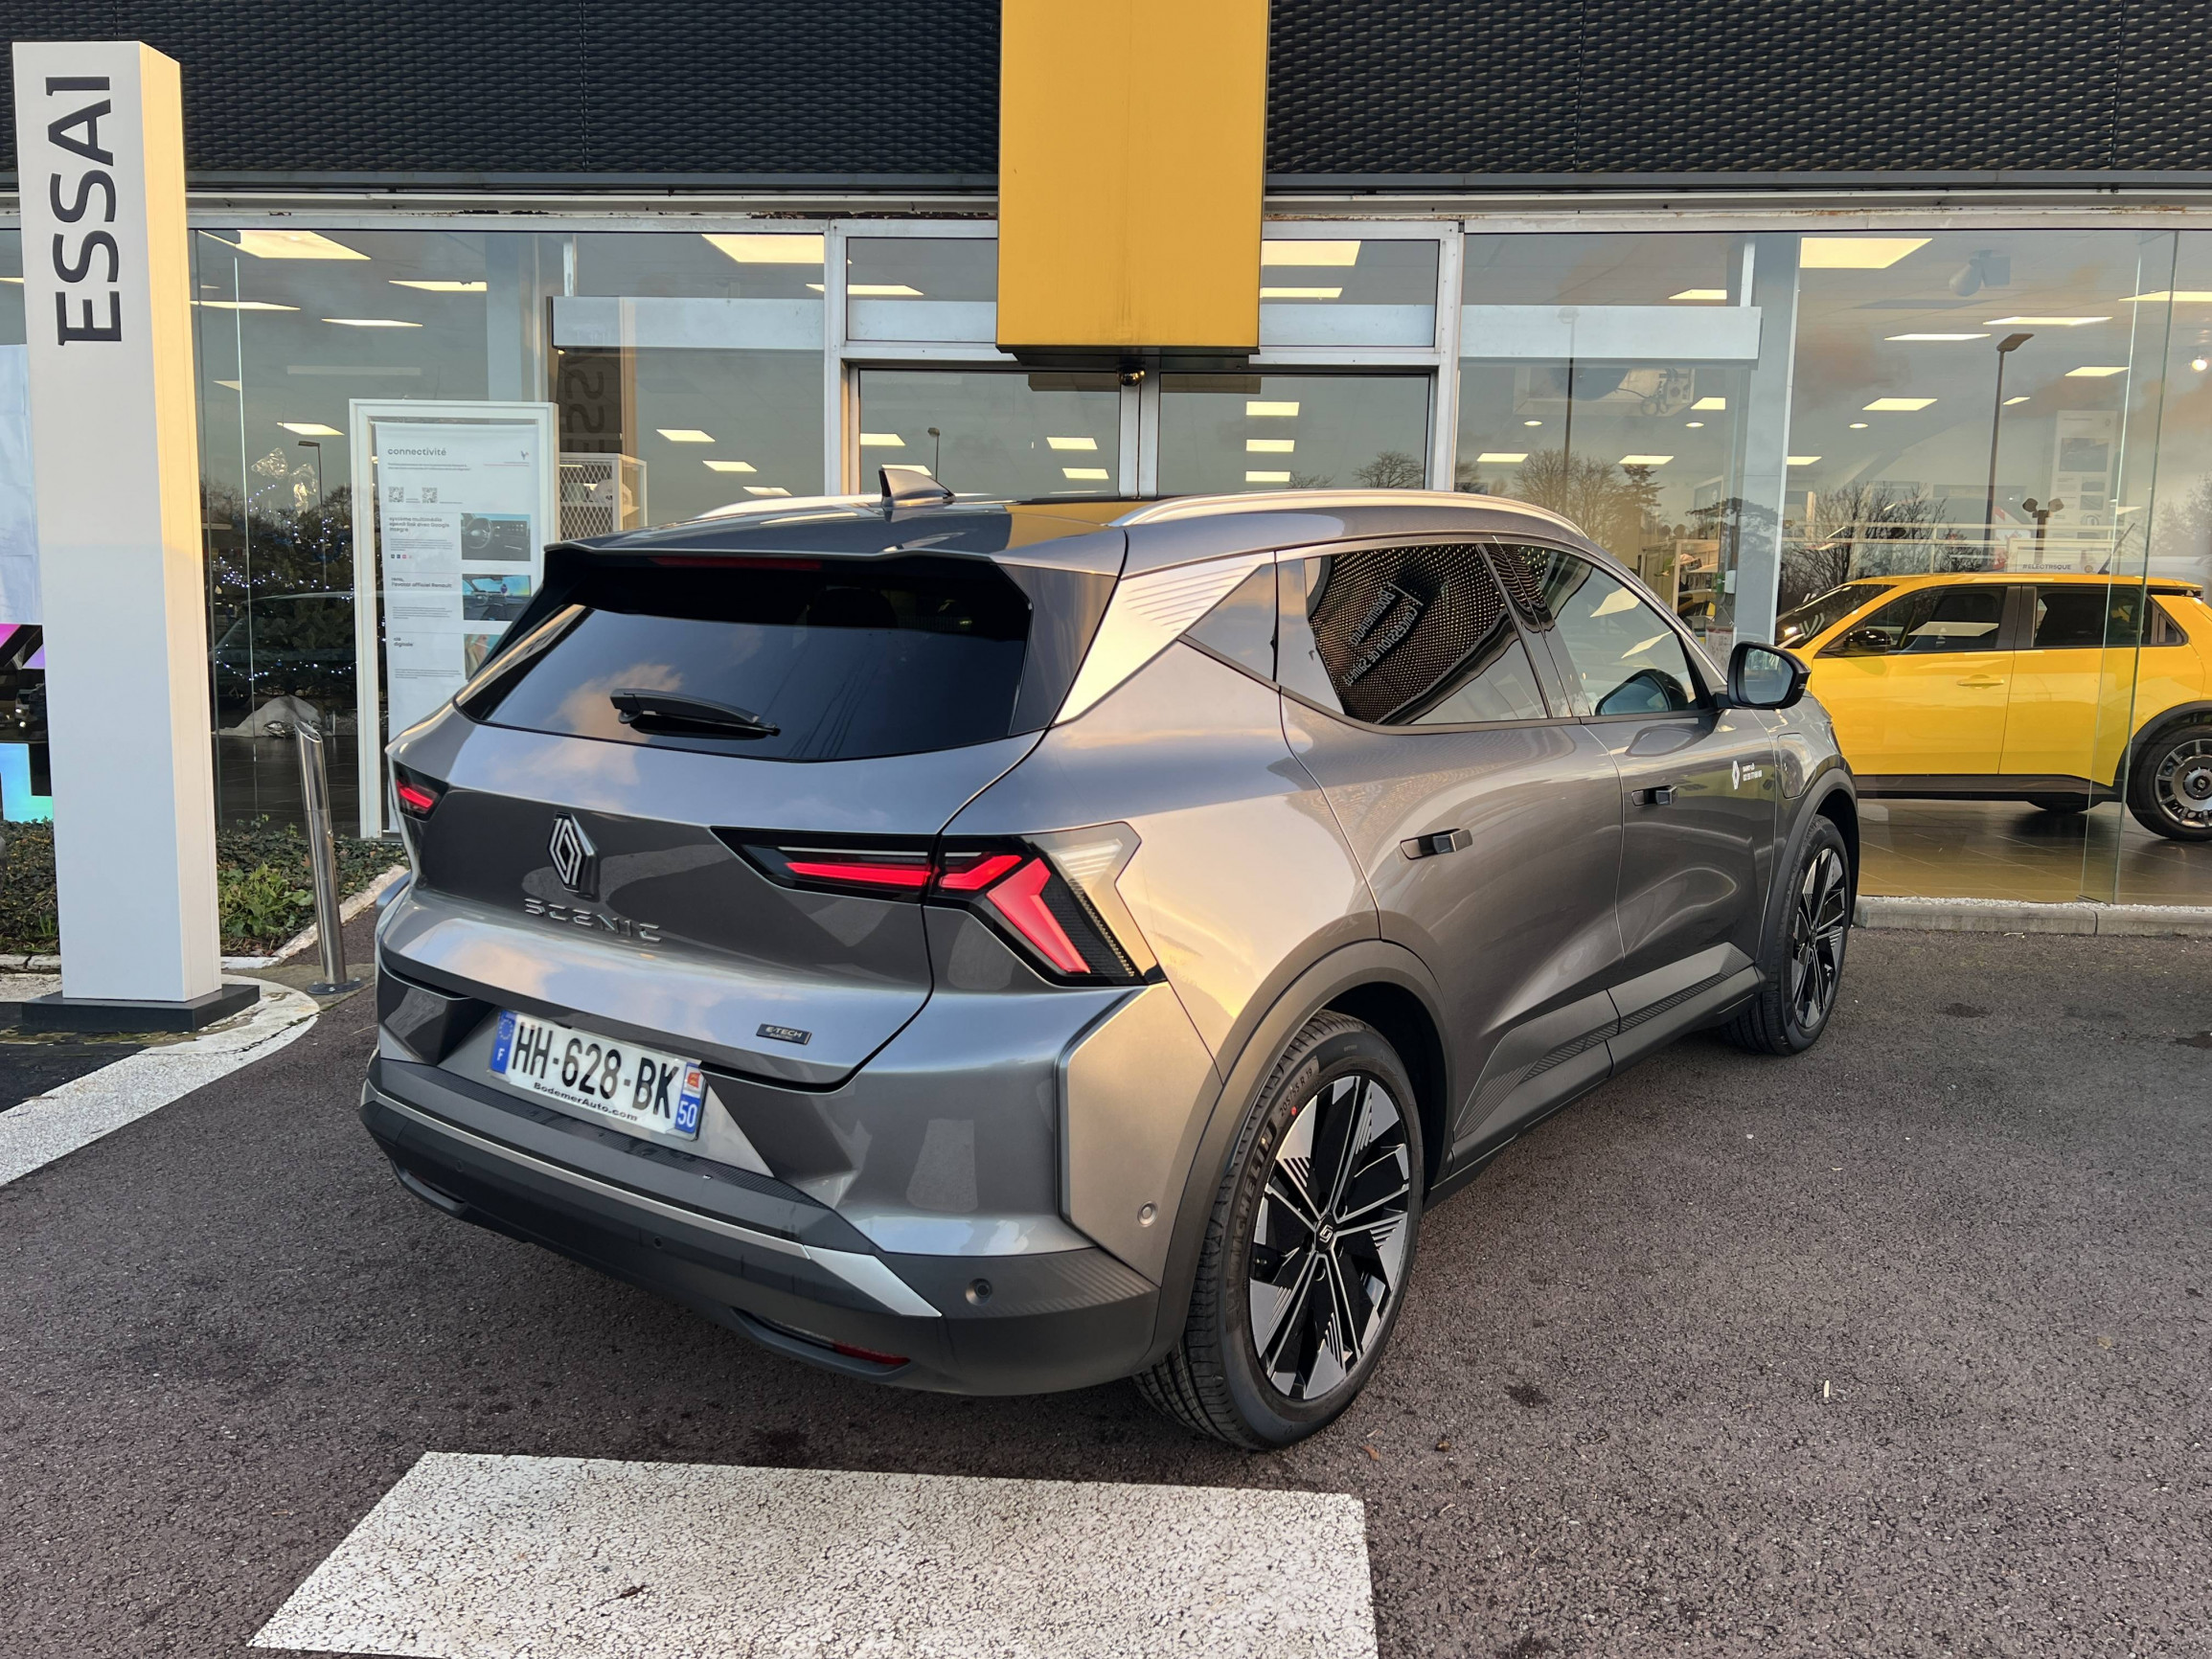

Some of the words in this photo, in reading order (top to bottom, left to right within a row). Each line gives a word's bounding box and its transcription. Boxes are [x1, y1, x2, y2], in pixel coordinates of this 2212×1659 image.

[45, 76, 122, 346] ESSAI
[387, 447, 447, 456] connectivité
[524, 898, 661, 943] SCENIC
[765, 1026, 803, 1038] E-TECH
[496, 1048, 505, 1061] F
[512, 1021, 679, 1120] HH-628-BK
[534, 1082, 638, 1122] BodemerAuto.com
[677, 1101, 697, 1128] 50
